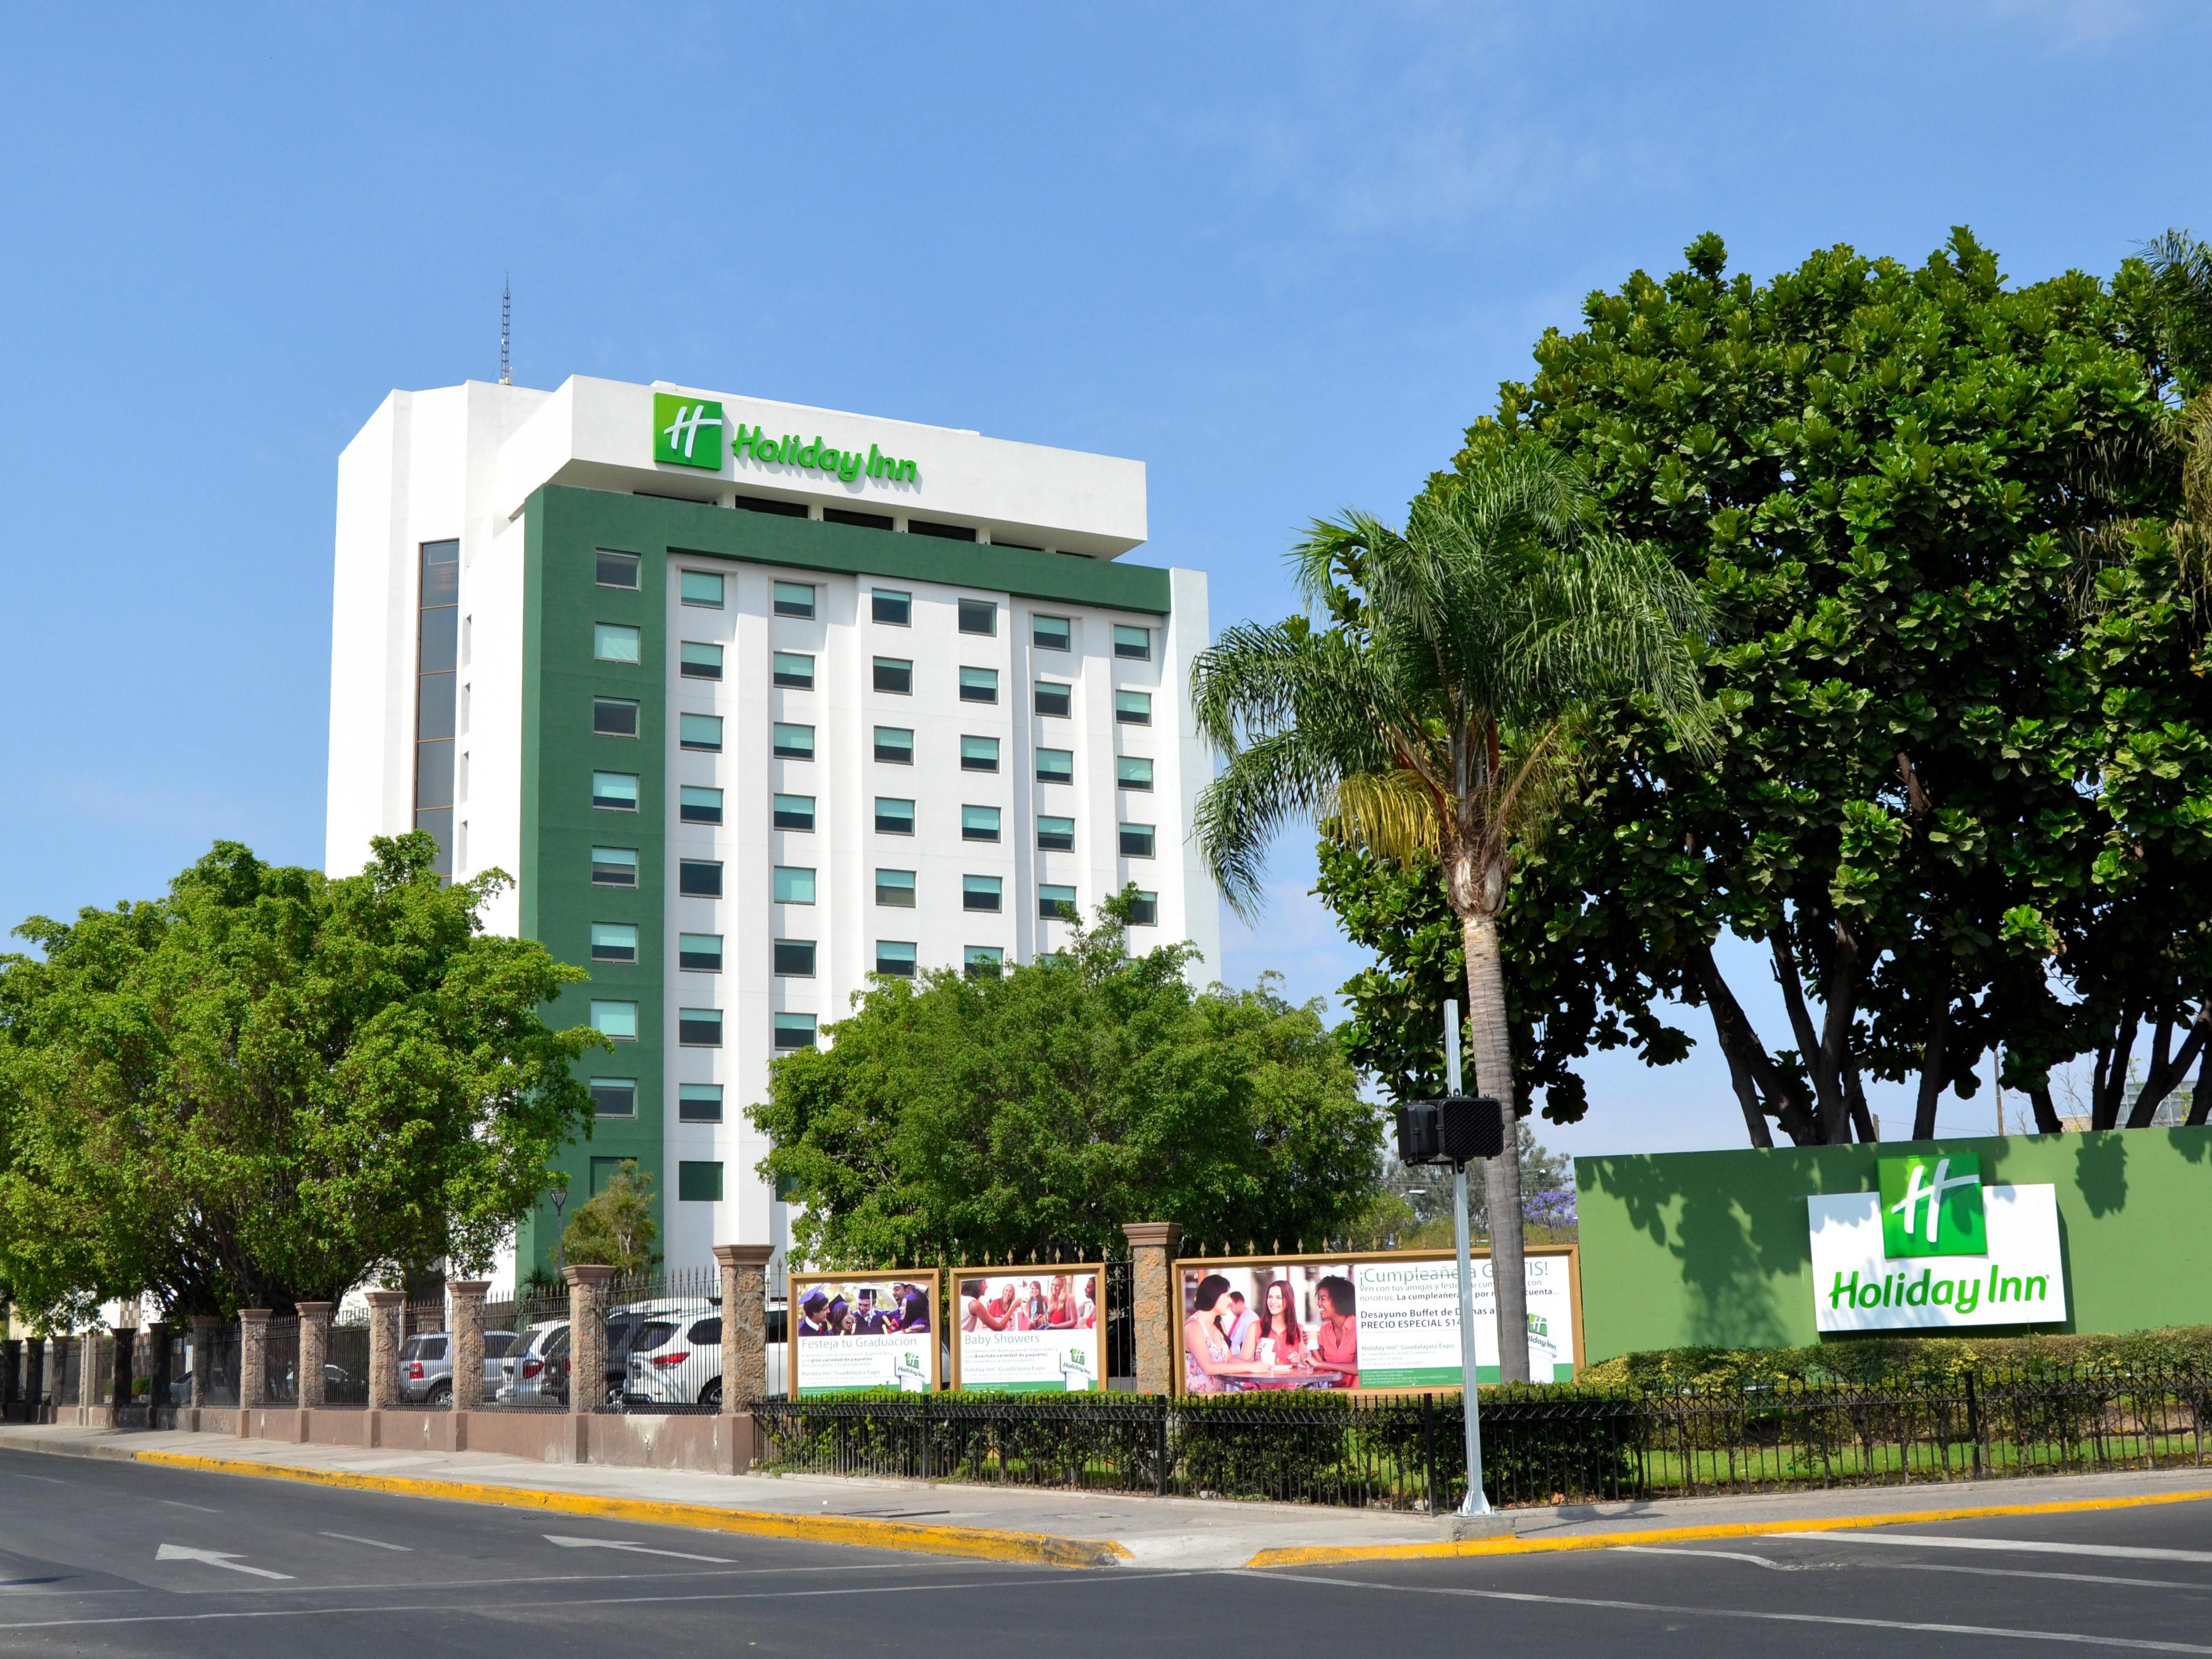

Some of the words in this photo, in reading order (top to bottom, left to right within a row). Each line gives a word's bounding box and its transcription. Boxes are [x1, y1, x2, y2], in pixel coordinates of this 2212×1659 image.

[732, 424, 862, 482] Holiday
[866, 444, 917, 483] Inn
[1406, 1284, 1433, 1292] amigas
[1829, 1269, 1980, 1314] Holiday
[1361, 1310, 1407, 1319] Desayuno
[1410, 1308, 1438, 1317] Buffet
[1441, 1308, 1453, 1316] de
[1361, 1320, 1396, 1329] PRECIO
[1398, 1318, 1443, 1328] ESPECIAL
[802, 1339, 838, 1350] Festeja
[842, 1340, 852, 1348] tu
[856, 1337, 917, 1348] Graduación
[965, 1334, 991, 1346] Baby
[994, 1333, 1040, 1344] Showers
[1547, 1340, 1557, 1350] Inn
[898, 1366, 918, 1376] Holiday
[1063, 1362, 1084, 1373] Holiday
